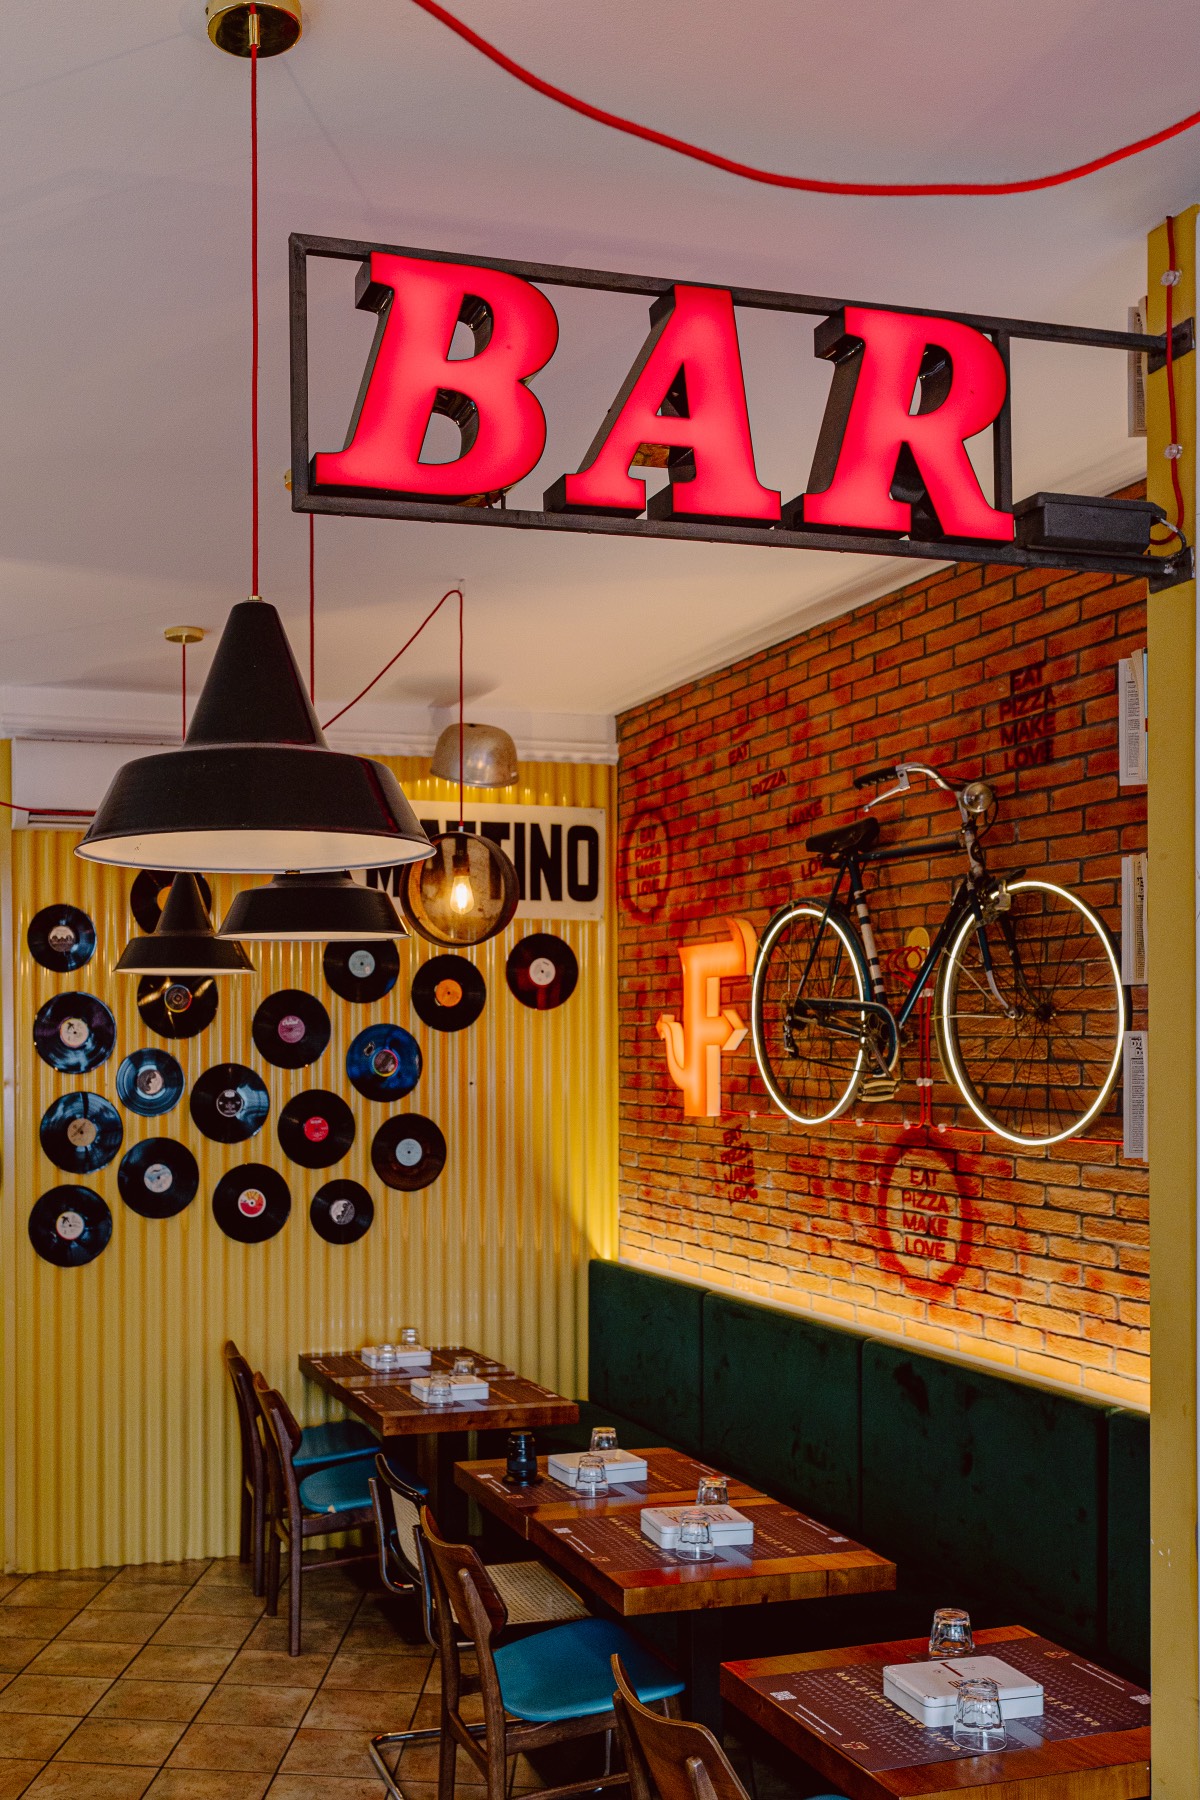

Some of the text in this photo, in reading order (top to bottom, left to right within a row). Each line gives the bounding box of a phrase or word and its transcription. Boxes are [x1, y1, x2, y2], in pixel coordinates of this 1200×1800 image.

[313, 251, 1015, 542] BAR
[1010, 661, 1046, 691] EAT
[999, 687, 1057, 721] PIZZA
[1000, 712, 1057, 746] MAKE
[728, 741, 750, 766] EAT
[1004, 739, 1055, 770] LOVE
[751, 770, 787, 800] PIZZA
[639, 825, 658, 844] EAT
[634, 843, 662, 861] PIZZA
[635, 860, 661, 879] MAKE
[801, 854, 824, 881] LOV
[910, 1168, 940, 1187] EAT
[901, 1191, 949, 1213] PIZZA
[902, 1212, 949, 1237] MAKE
[905, 1236, 947, 1260] LOVE
